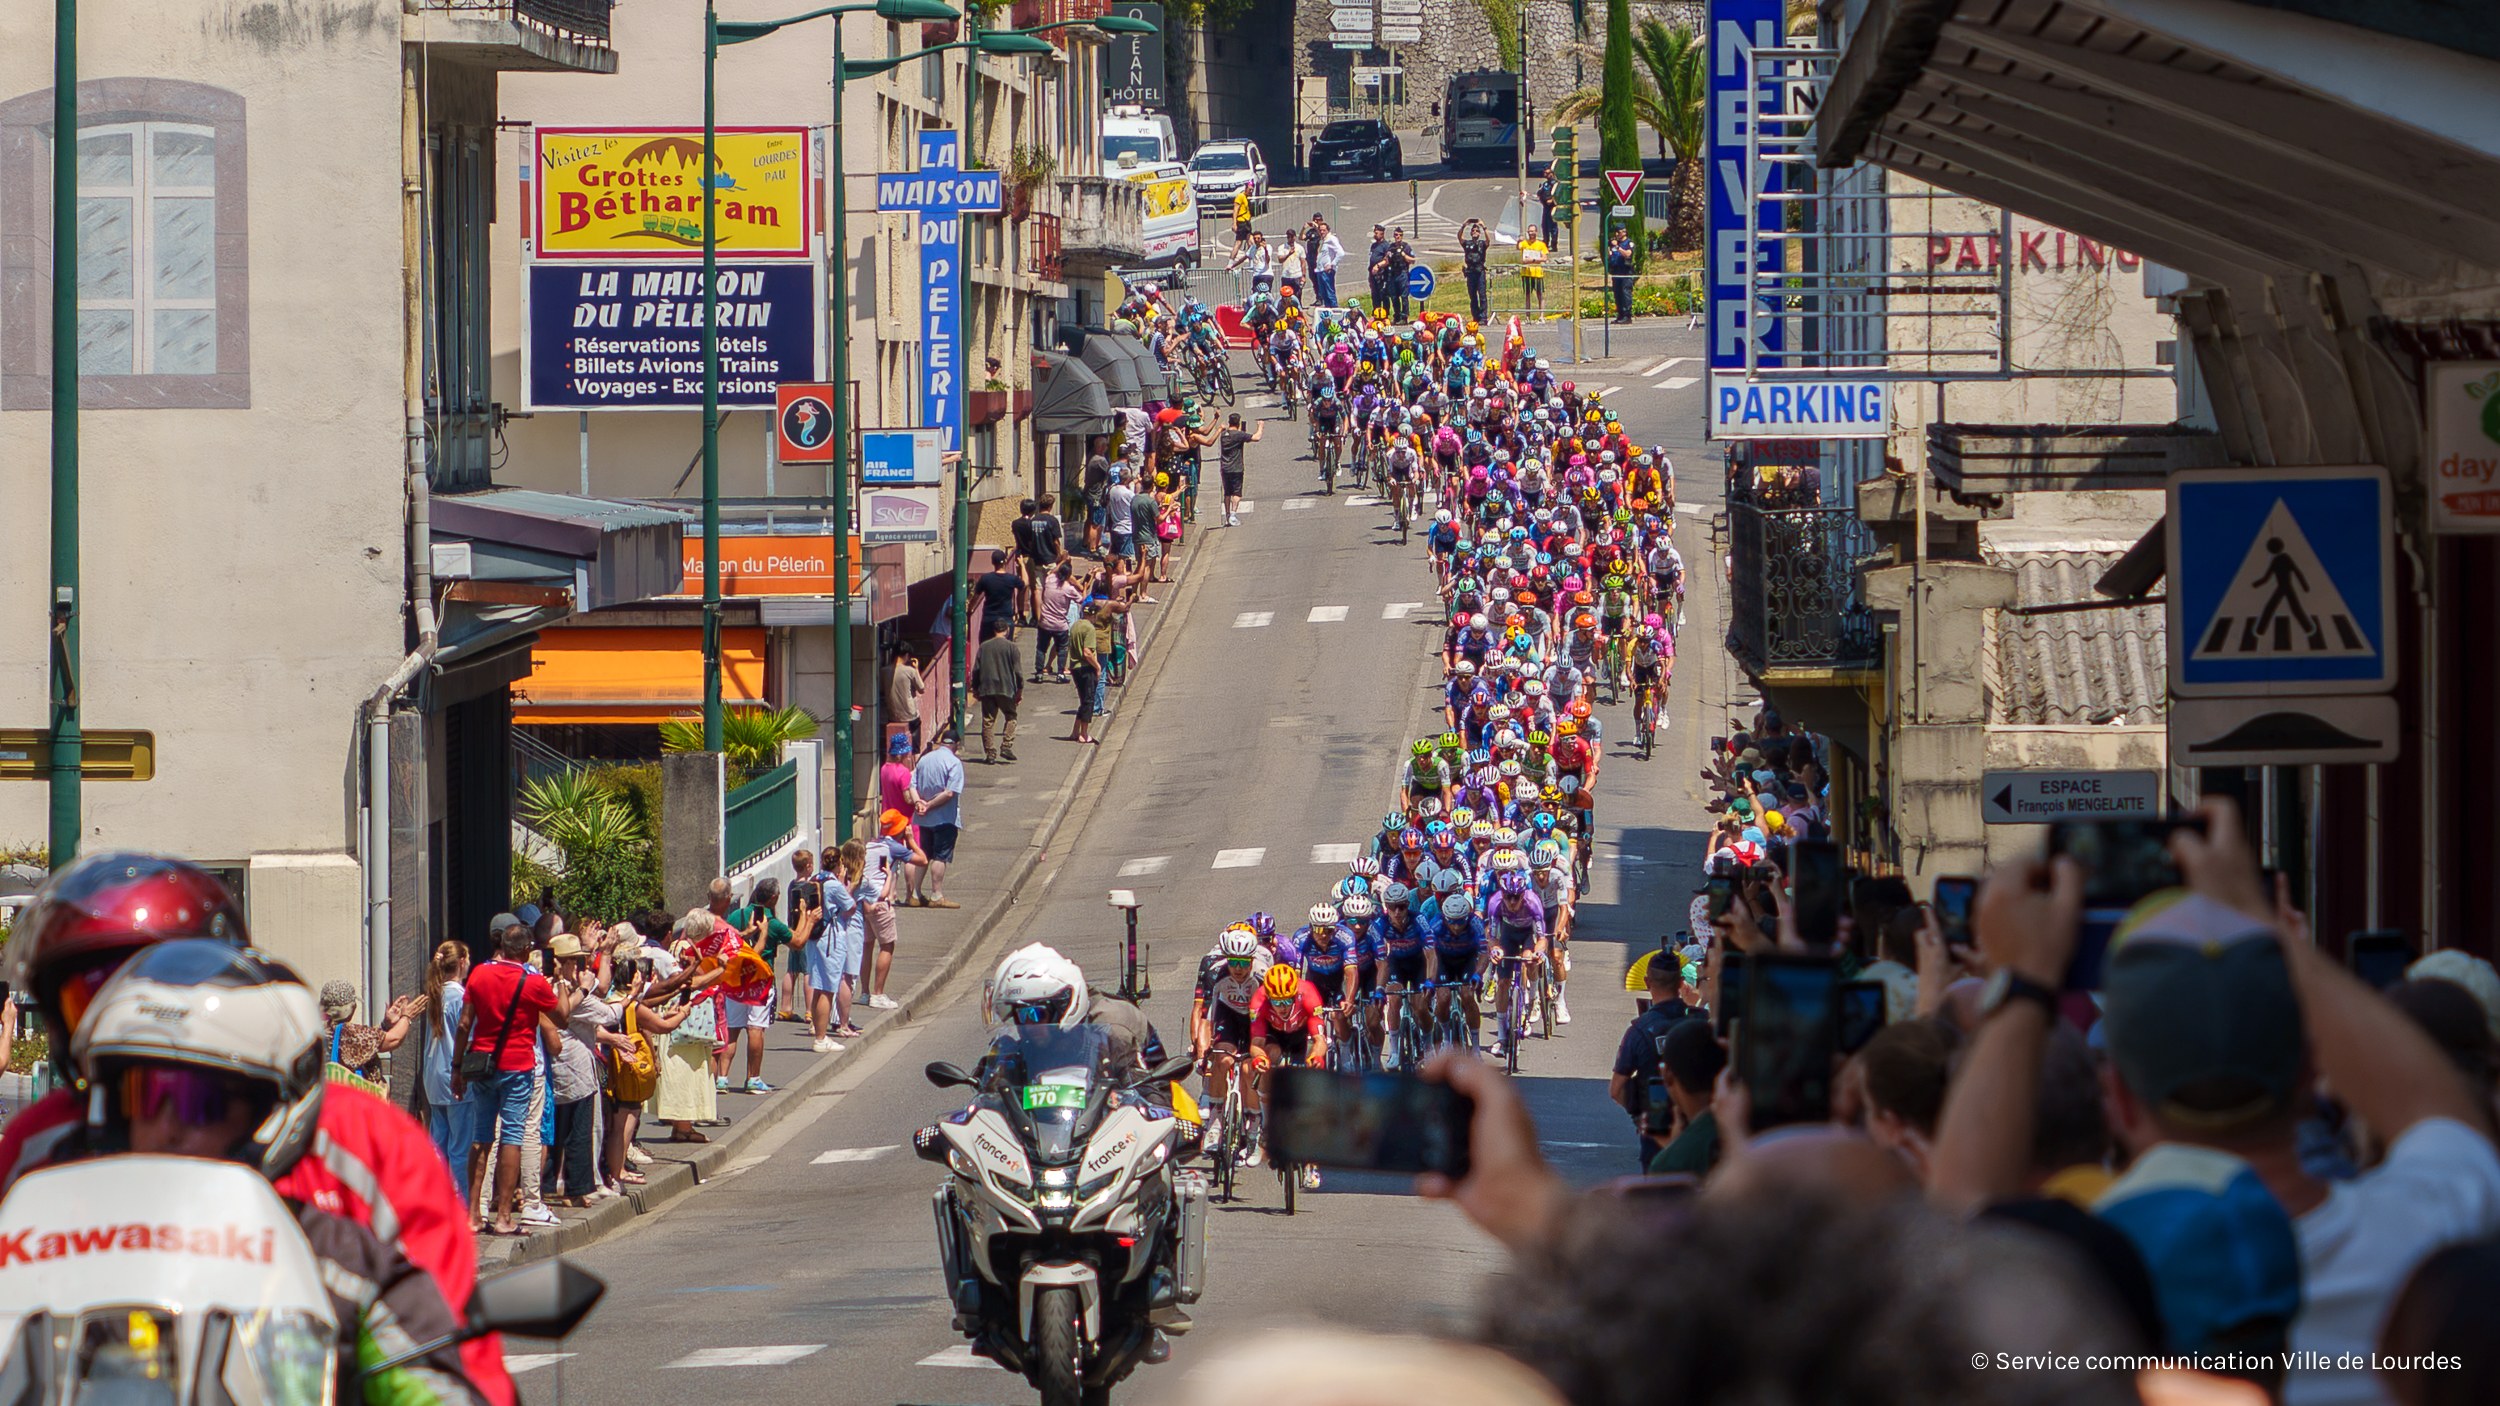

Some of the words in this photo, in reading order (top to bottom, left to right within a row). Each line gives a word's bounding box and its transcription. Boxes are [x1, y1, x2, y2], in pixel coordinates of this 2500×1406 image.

[1129, 8, 1142, 86] OÉAN
[1112, 86, 1161, 100] HÔTEL
[766, 139, 783, 149] Entre
[541, 143, 602, 170] Visitez
[604, 139, 618, 150] les
[753, 149, 797, 168] LOURDES
[920, 143, 955, 168] LA
[578, 164, 683, 187] Grottes
[764, 169, 786, 183] PAU
[880, 180, 997, 205] MAISON
[921, 220, 957, 244] DU
[579, 271, 619, 296] LA
[573, 302, 622, 327] DU
[574, 337, 700, 353] Réservations
[928, 258, 953, 451] PELERIN
[574, 358, 635, 374] Billets
[639, 358, 704, 374] Avions
[719, 357, 779, 373] Trains
[574, 378, 657, 398] Voyages
[673, 378, 777, 394] Excrsions
[1719, 384, 1881, 424] PARKING
[865, 461, 888, 469] AIR
[865, 469, 913, 477] FRANCE
[2440, 452, 2497, 484] day
[875, 507, 928, 523] SNCF
[875, 533, 900, 541] Agence
[683, 557, 738, 573] Maon
[742, 557, 763, 573] du
[767, 556, 825, 573] Pélerin
[2040, 780, 2101, 794] ESPACE
[2018, 799, 2064, 815] François
[2067, 797, 2144, 811] MENGELATTE
[1030, 1091, 1056, 1106] 170
[0, 1222, 275, 1268] Kawasaki
